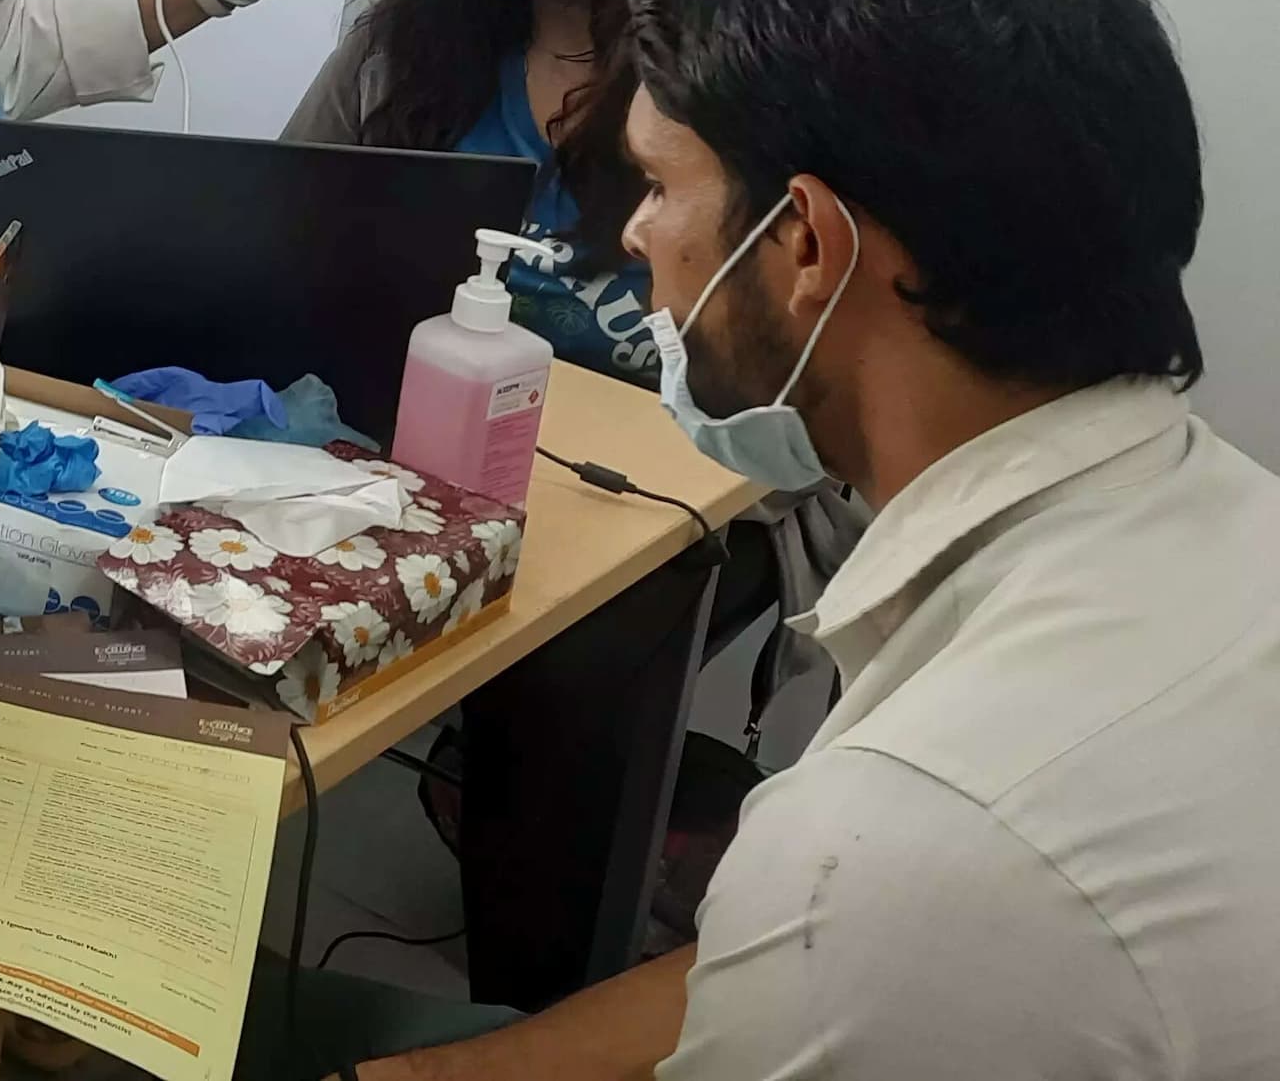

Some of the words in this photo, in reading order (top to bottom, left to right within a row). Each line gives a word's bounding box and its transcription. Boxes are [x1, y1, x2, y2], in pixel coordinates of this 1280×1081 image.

[55, 934, 85, 950] Dental
[13, 990, 24, 1001] of
[25, 995, 46, 1010] Oral
[36, 989, 69, 1009] advised
[70, 1003, 81, 1016] by
[82, 1009, 98, 1021] the
[99, 1015, 133, 1036] Dentist
